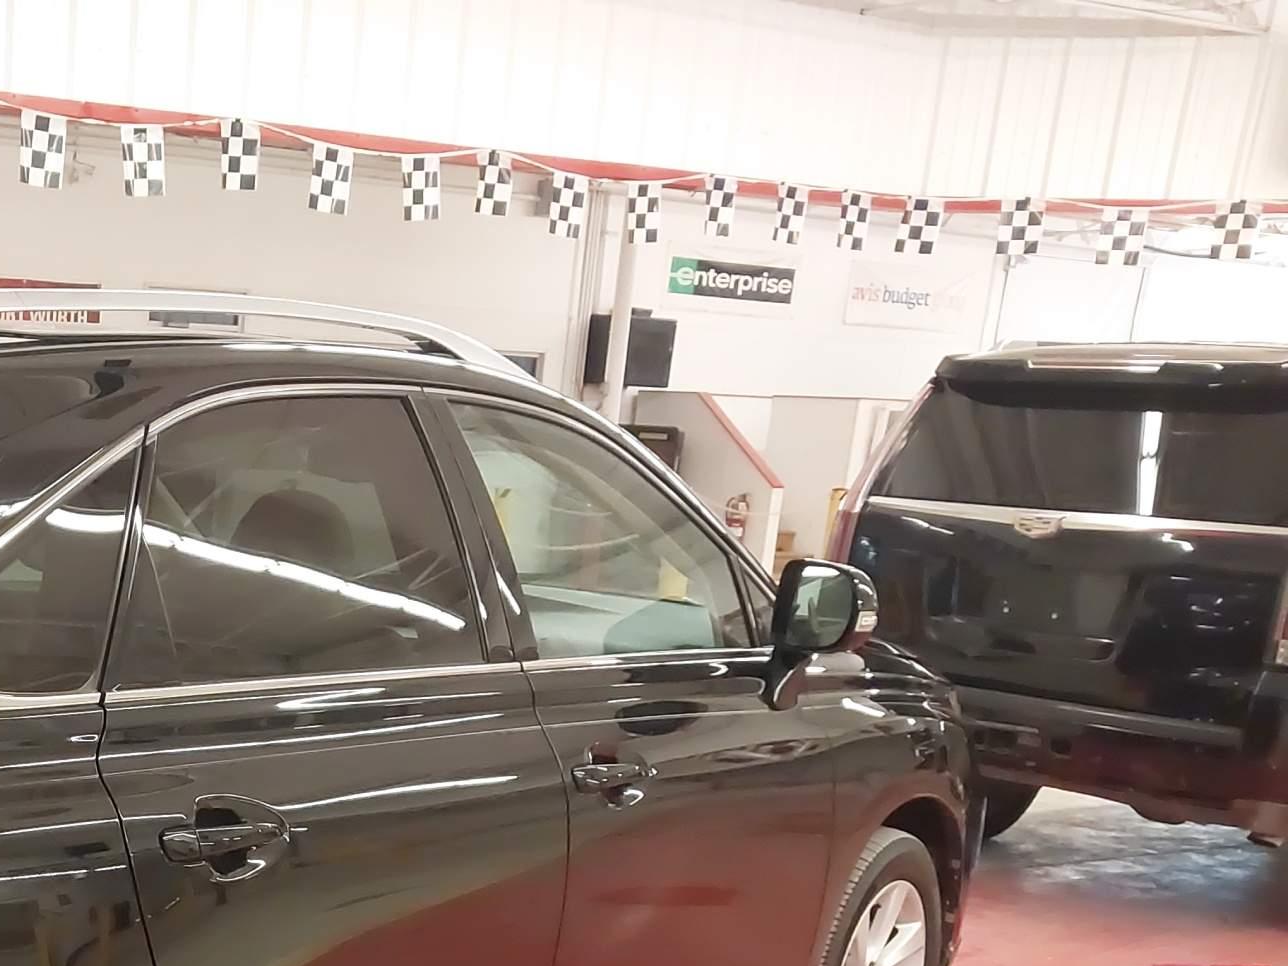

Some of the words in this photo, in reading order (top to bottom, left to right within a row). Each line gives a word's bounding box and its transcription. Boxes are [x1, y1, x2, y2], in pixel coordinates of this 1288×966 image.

[670, 266, 793, 296] enterprise
[851, 281, 880, 302] avis
[881, 284, 932, 310] budget
